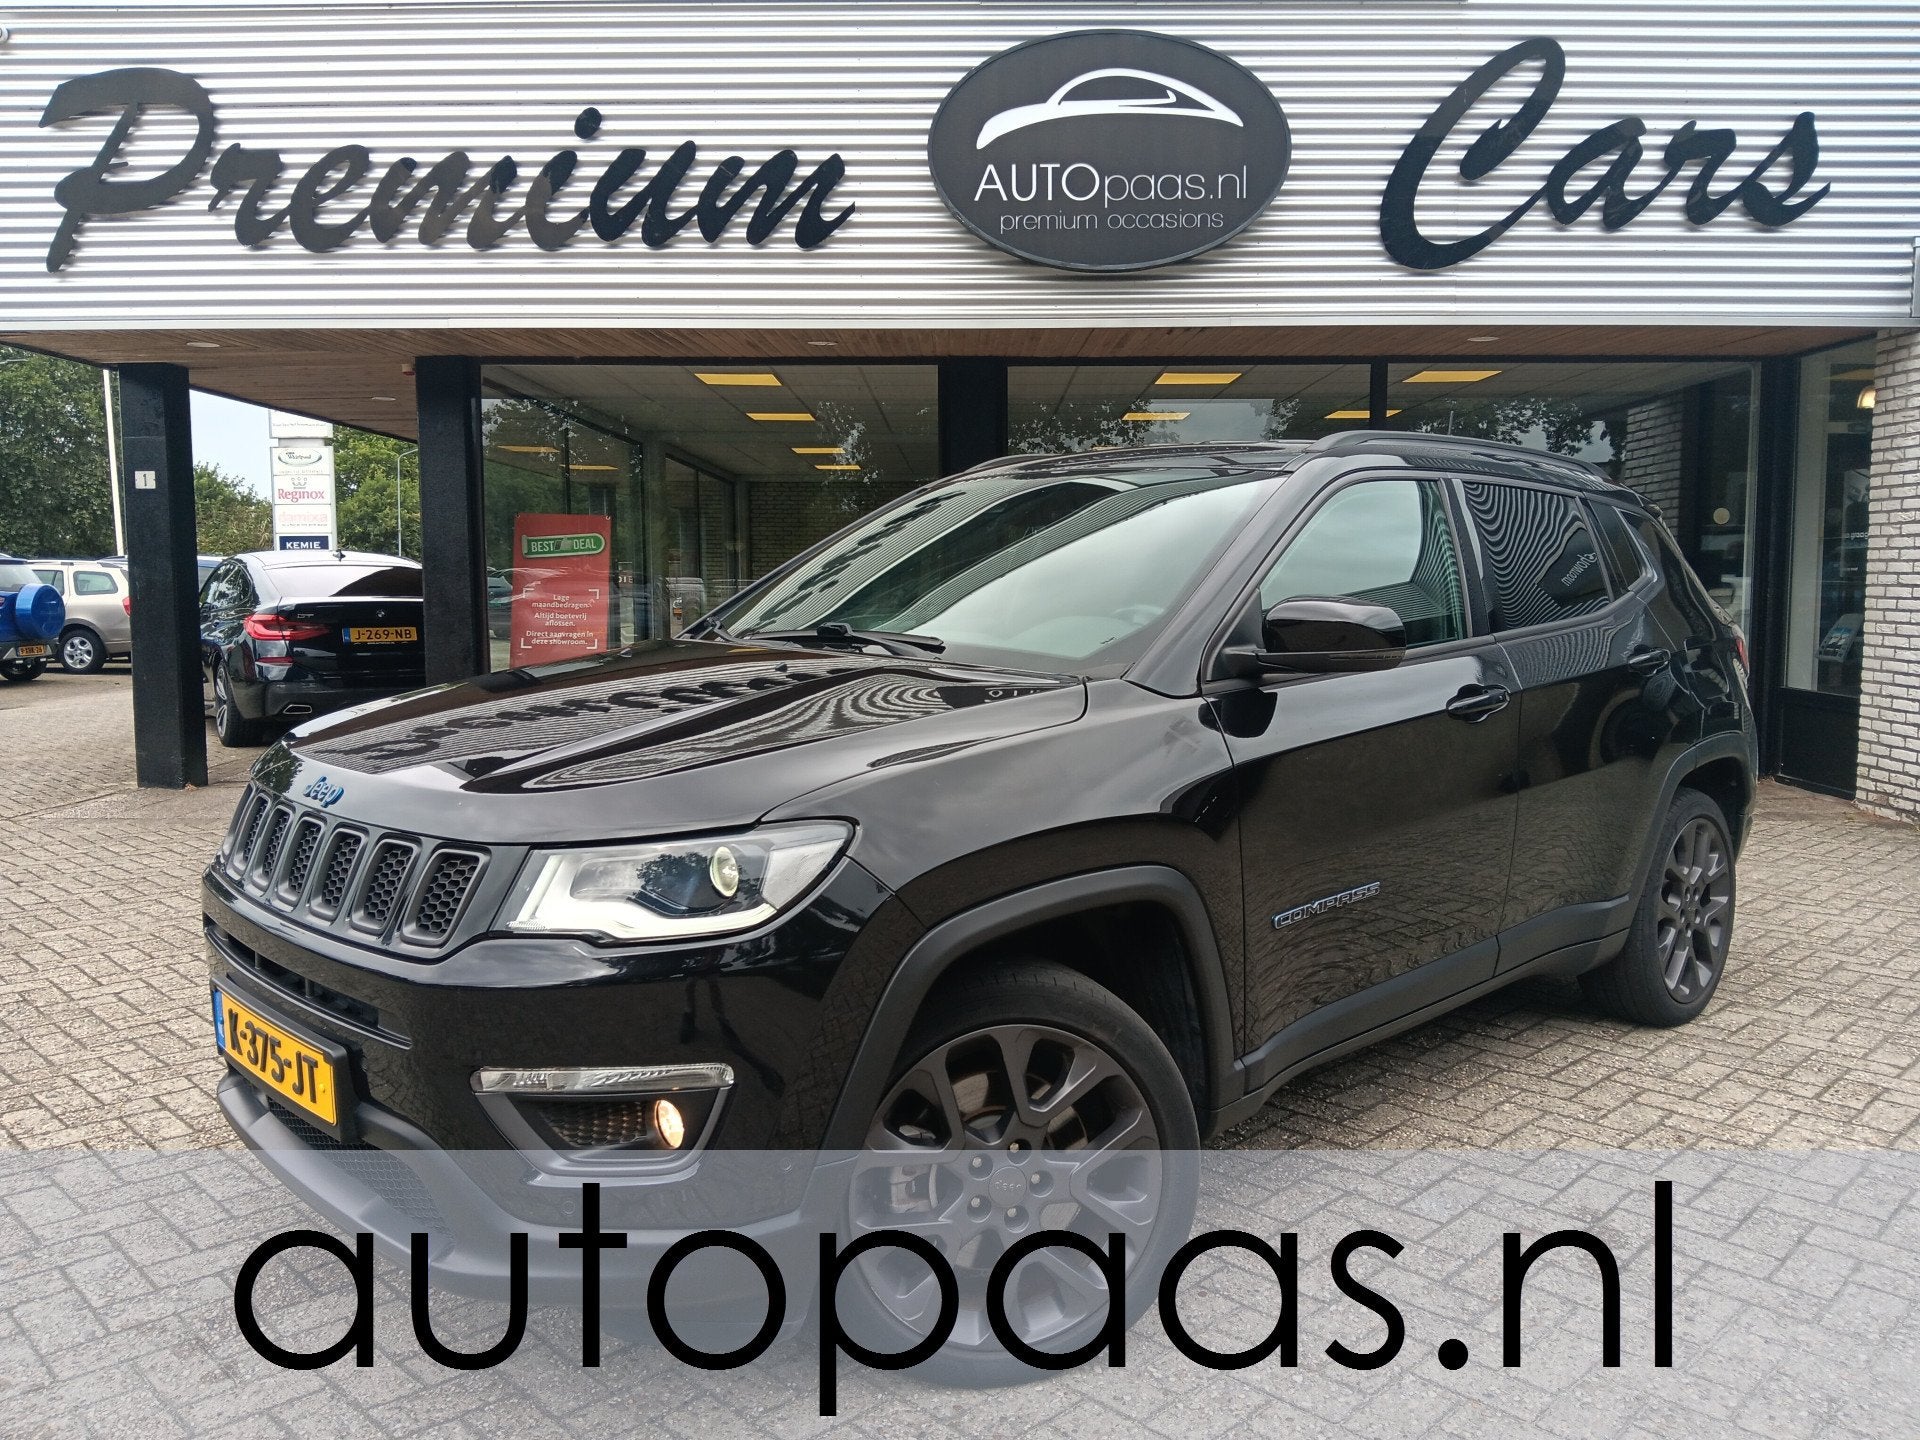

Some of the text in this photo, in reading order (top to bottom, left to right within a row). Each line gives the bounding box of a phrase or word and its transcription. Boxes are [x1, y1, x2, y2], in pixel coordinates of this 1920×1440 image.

[1380, 37, 1831, 269] Cars
[38, 67, 855, 273] Premium
[974, 163, 1247, 208] AUTOpaas.nl
[1000, 208, 1224, 234] premium occasions
[142, 473, 148, 487] 1
[278, 488, 326, 503] Reginox
[286, 541, 322, 550] KEMIE
[531, 539, 597, 552] BEST DEAL
[553, 594, 570, 602] Lage
[534, 612, 587, 621] Altijd boetevrij
[355, 629, 412, 640] J-269-NB
[526, 630, 548, 638] Direct
[549, 631, 586, 639] aanvragen
[303, 776, 345, 808] Jeep
[1271, 881, 1380, 929] COMPASS
[228, 1007, 318, 1104] K-375-JT
